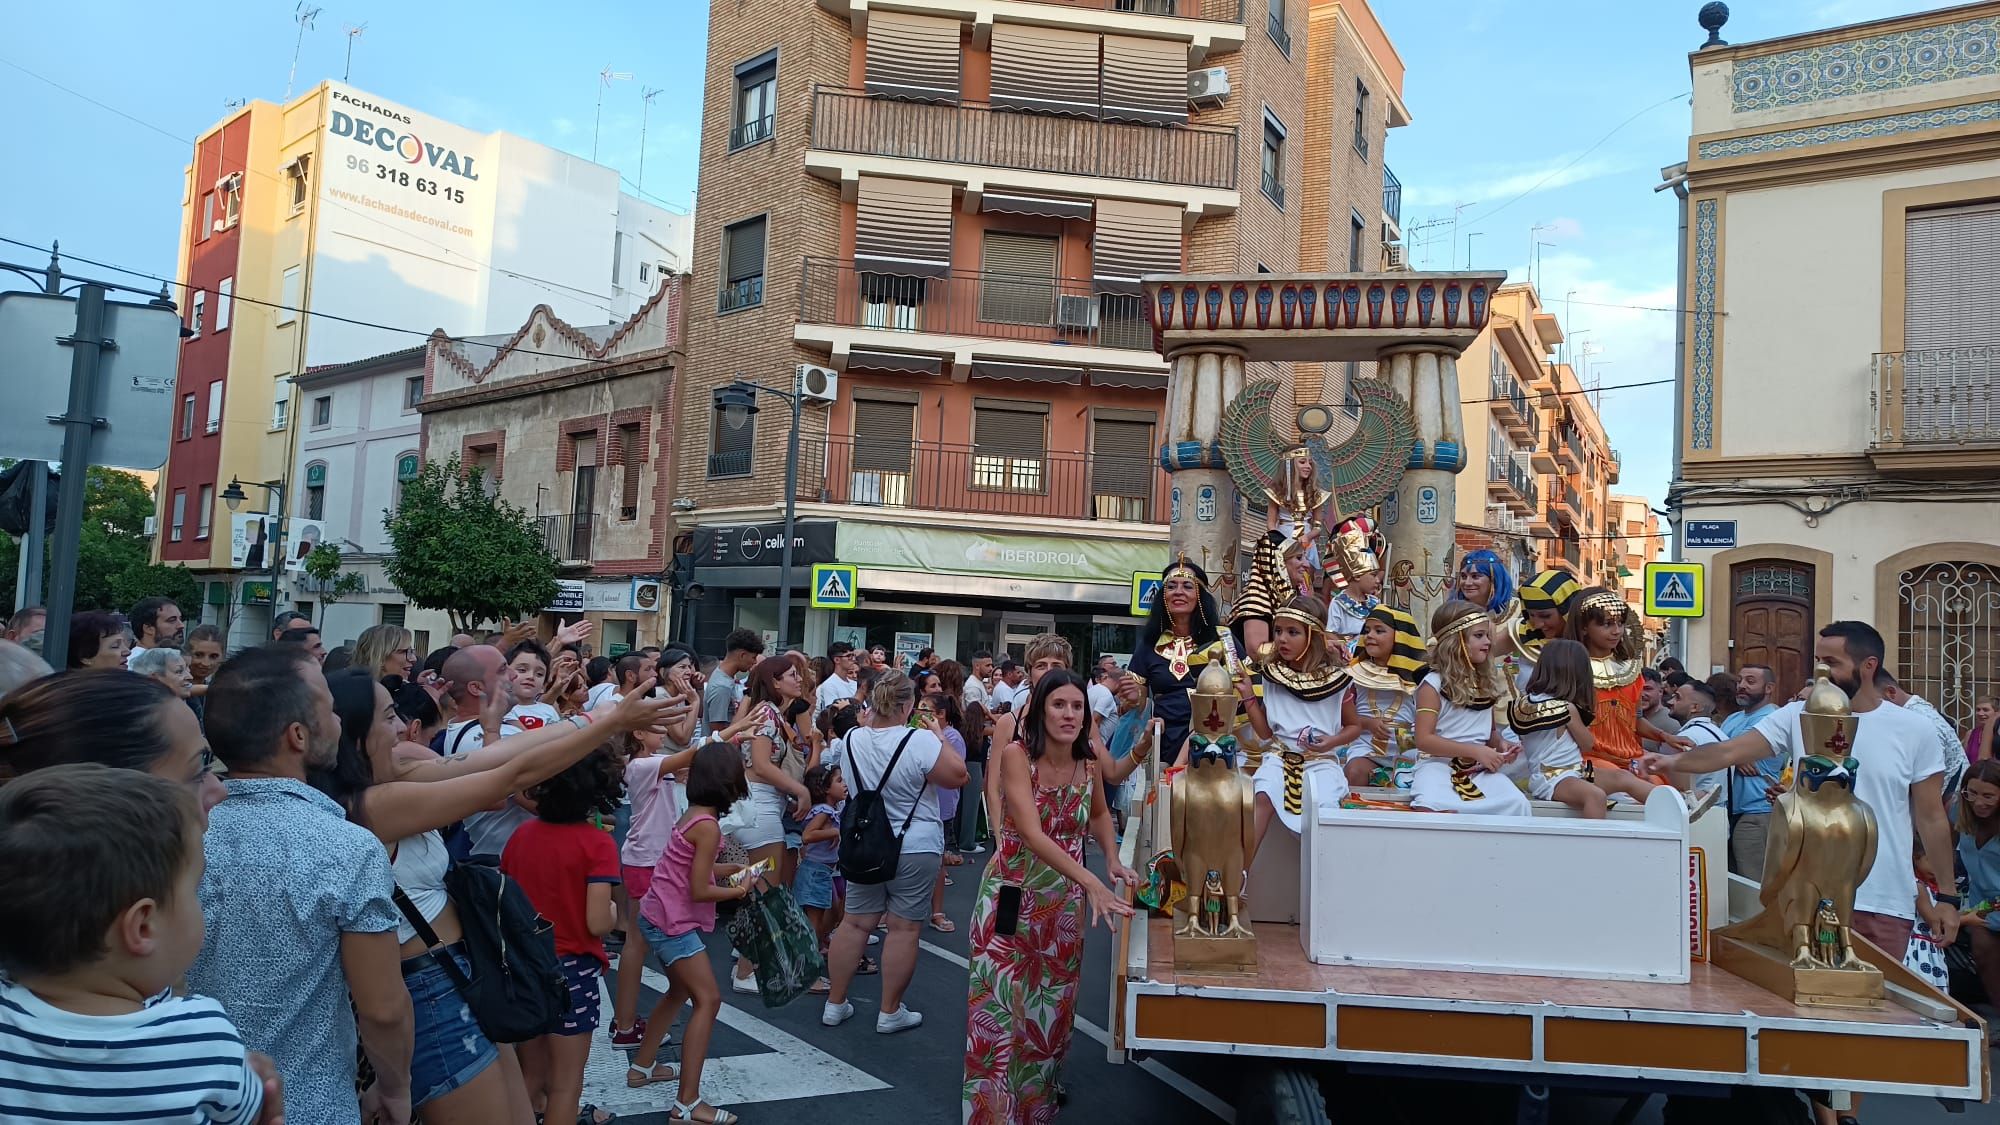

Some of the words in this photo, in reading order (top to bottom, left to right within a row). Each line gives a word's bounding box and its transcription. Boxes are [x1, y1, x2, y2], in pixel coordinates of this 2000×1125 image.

[333, 91, 411, 124] FACHADAS
[330, 110, 479, 181] DECOVAL
[346, 154, 370, 174] 96
[376, 164, 409, 187] 318
[416, 178, 437, 196] 63
[444, 186, 465, 204] 15
[329, 186, 474, 238] www.fachadasdecoval.com
[765, 533, 805, 549] cellcm
[1001, 549, 1089, 566] IBERDROLA
